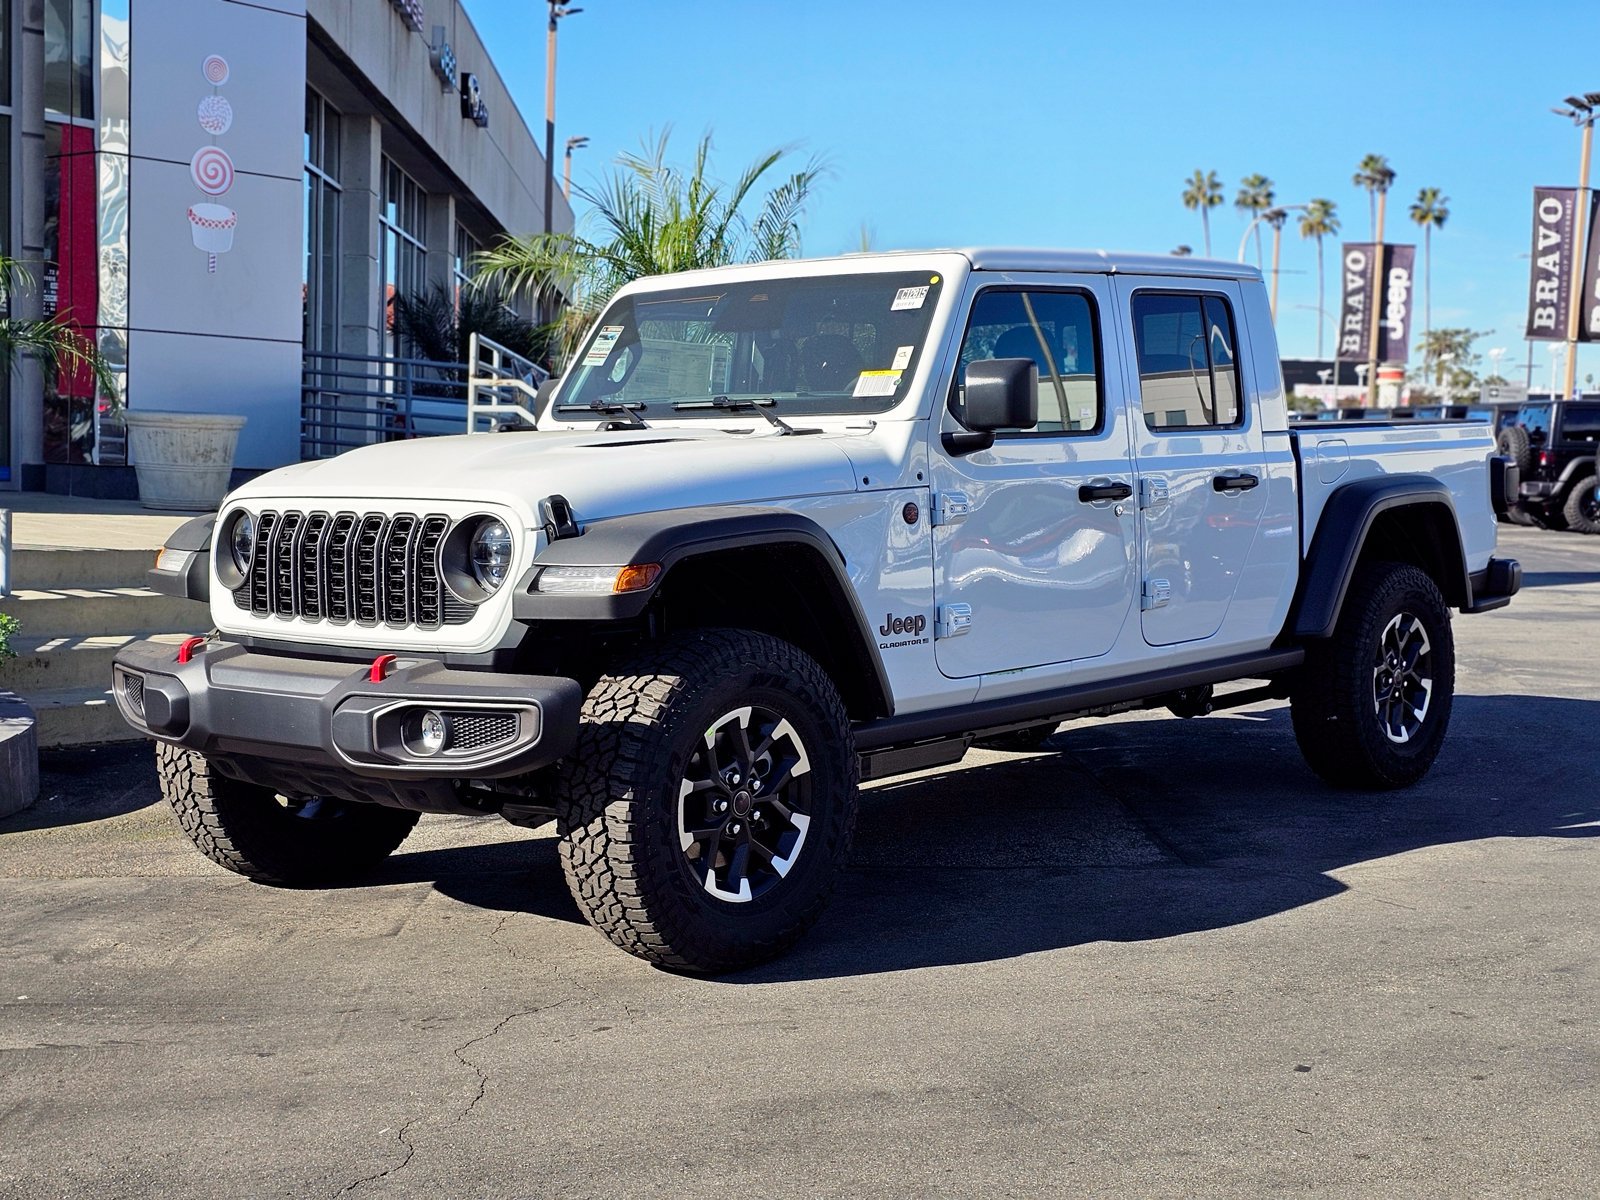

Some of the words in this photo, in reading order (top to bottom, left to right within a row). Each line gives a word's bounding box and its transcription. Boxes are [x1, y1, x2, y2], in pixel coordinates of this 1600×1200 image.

[1533, 197, 1563, 330] BRAVO
[1341, 250, 1366, 353] BRAVO
[1379, 267, 1411, 340] Jeep
[879, 613, 926, 636] Jeep
[879, 638, 922, 650] GLADIATOR
